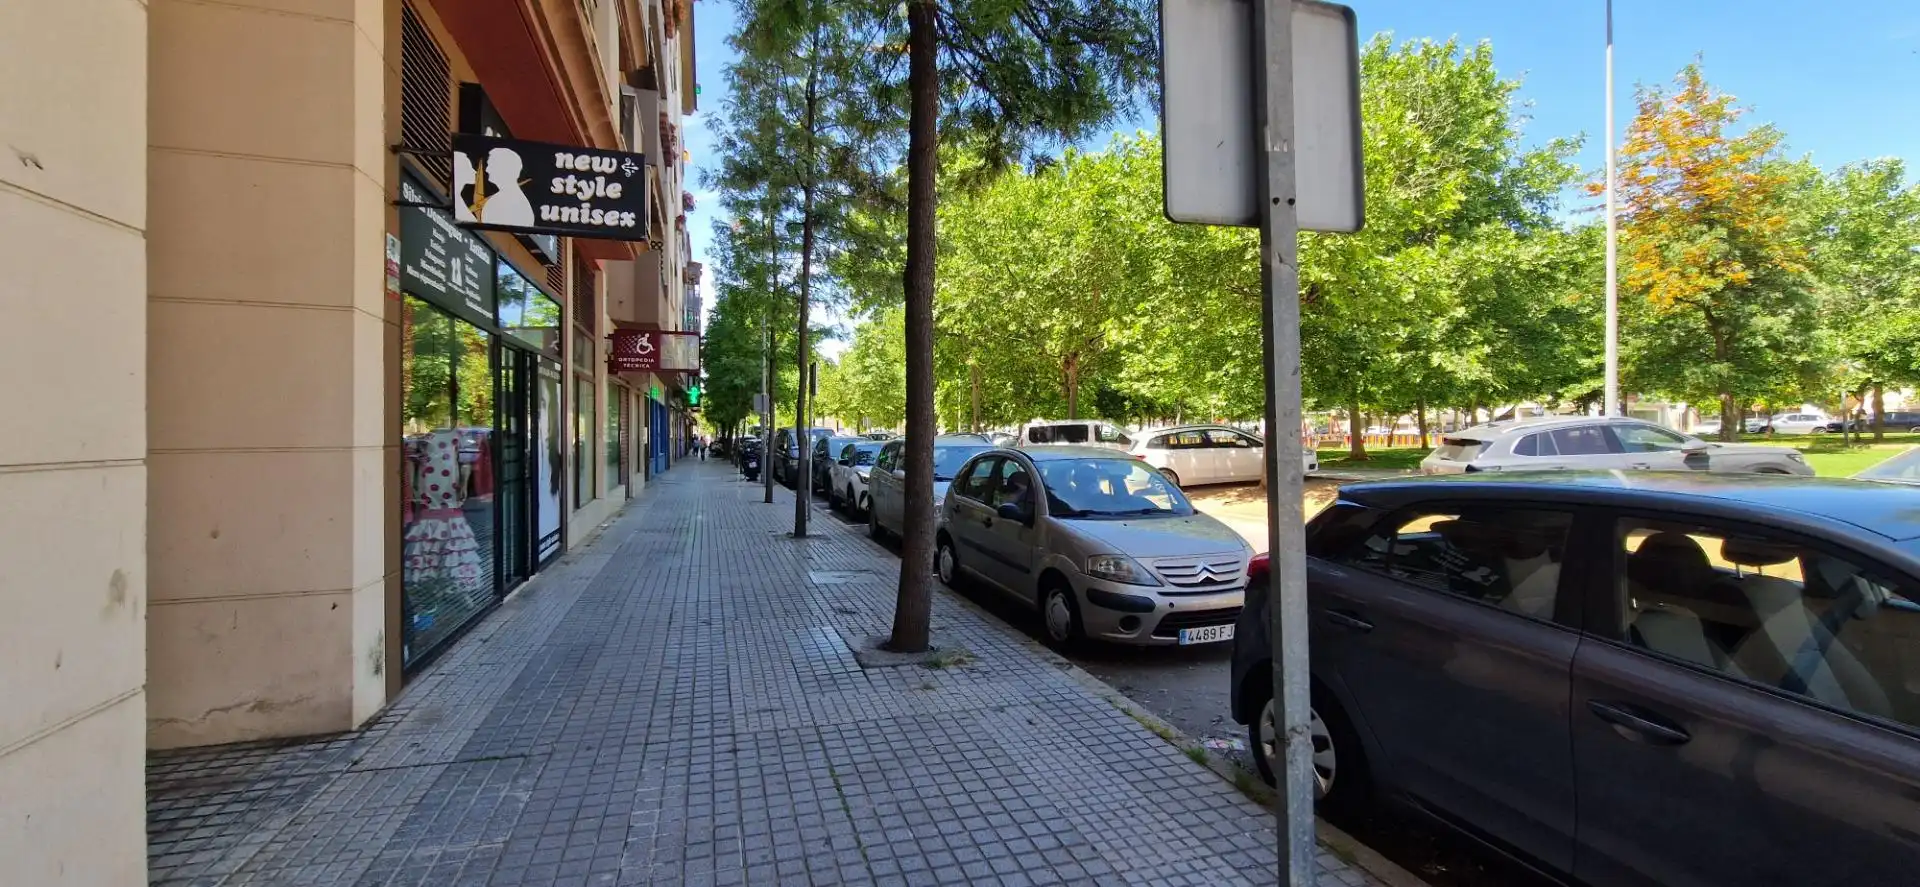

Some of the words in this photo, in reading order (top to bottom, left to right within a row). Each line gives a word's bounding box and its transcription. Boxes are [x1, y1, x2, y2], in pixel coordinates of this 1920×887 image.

[554, 152, 617, 174] new
[550, 174, 622, 201] style
[540, 202, 636, 228] unisex
[1188, 628, 1216, 641] 4489
